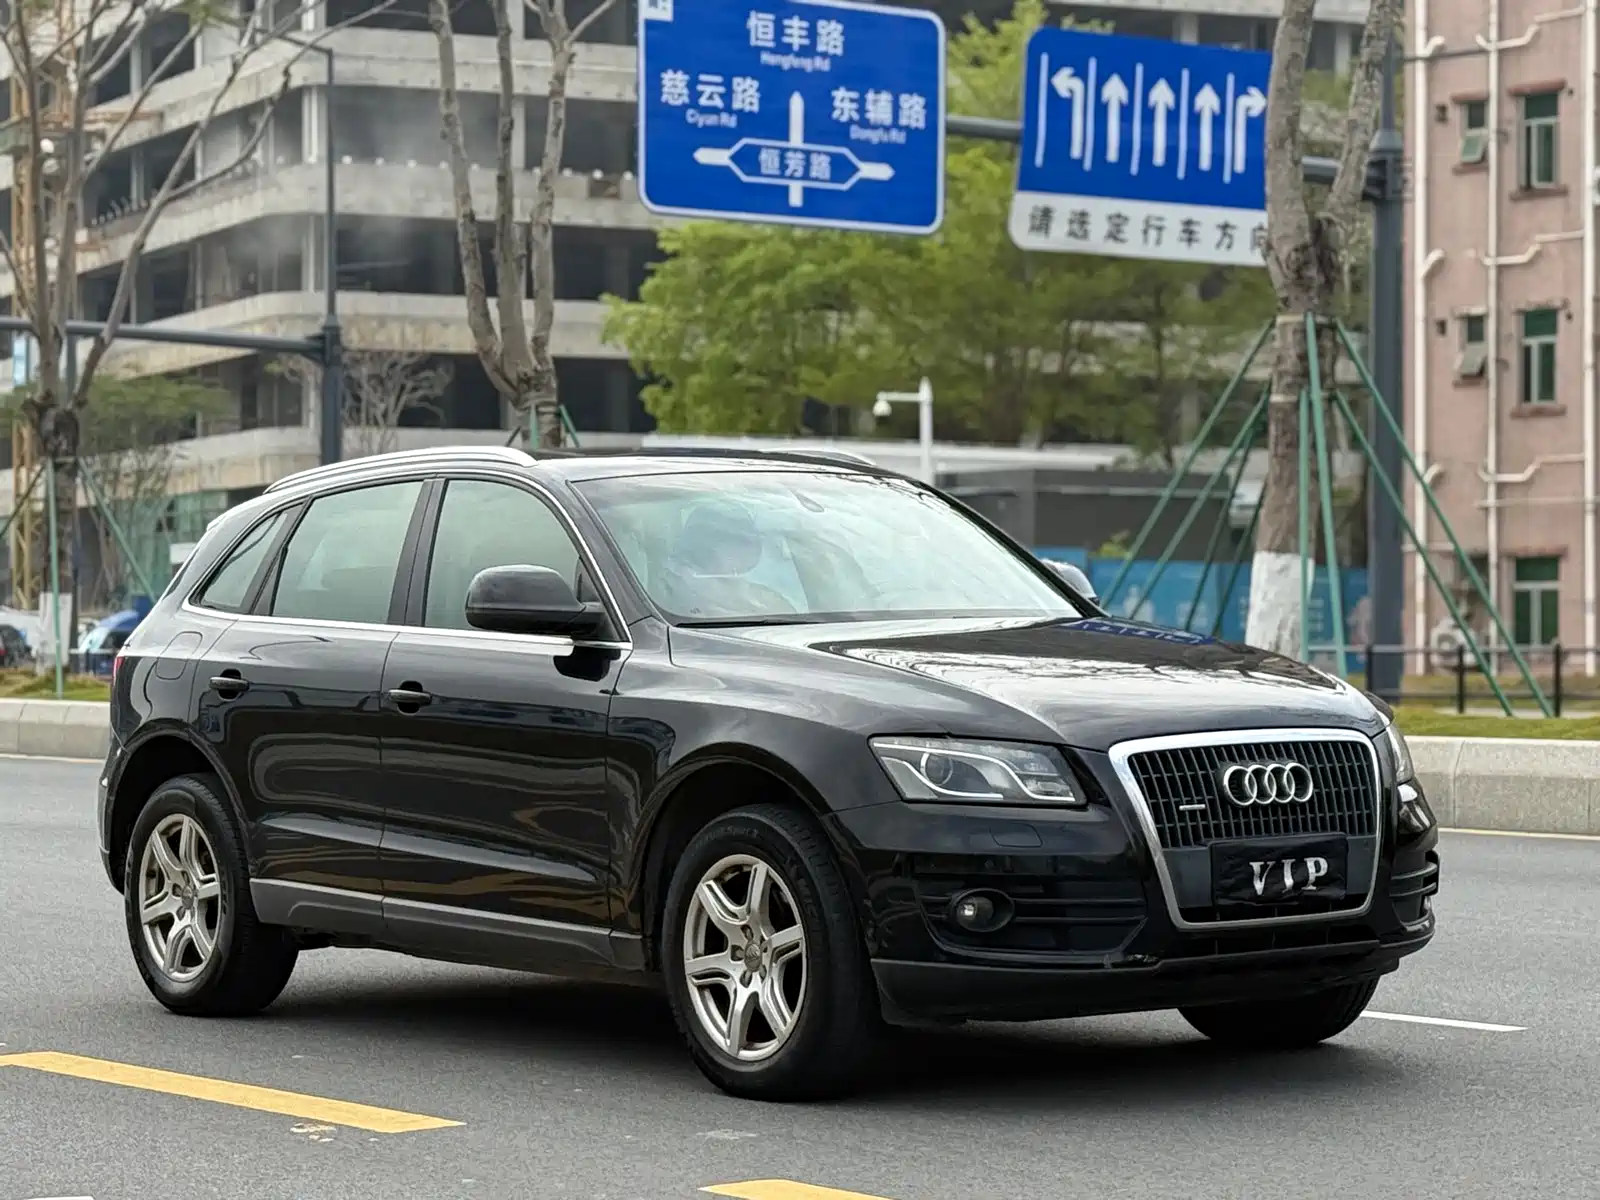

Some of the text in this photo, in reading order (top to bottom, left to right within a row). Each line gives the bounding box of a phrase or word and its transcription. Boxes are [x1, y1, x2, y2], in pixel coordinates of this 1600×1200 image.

[746, 10, 845, 57] 恒丰路
[813, 55, 831, 72] Rd
[660, 68, 761, 114] 慈云路
[831, 86, 927, 130] 东辅路
[685, 108, 738, 128] Ciyun Rd
[889, 127, 906, 144] Rd
[758, 147, 831, 181] 恒芳路
[1249, 856, 1328, 896] VIP
